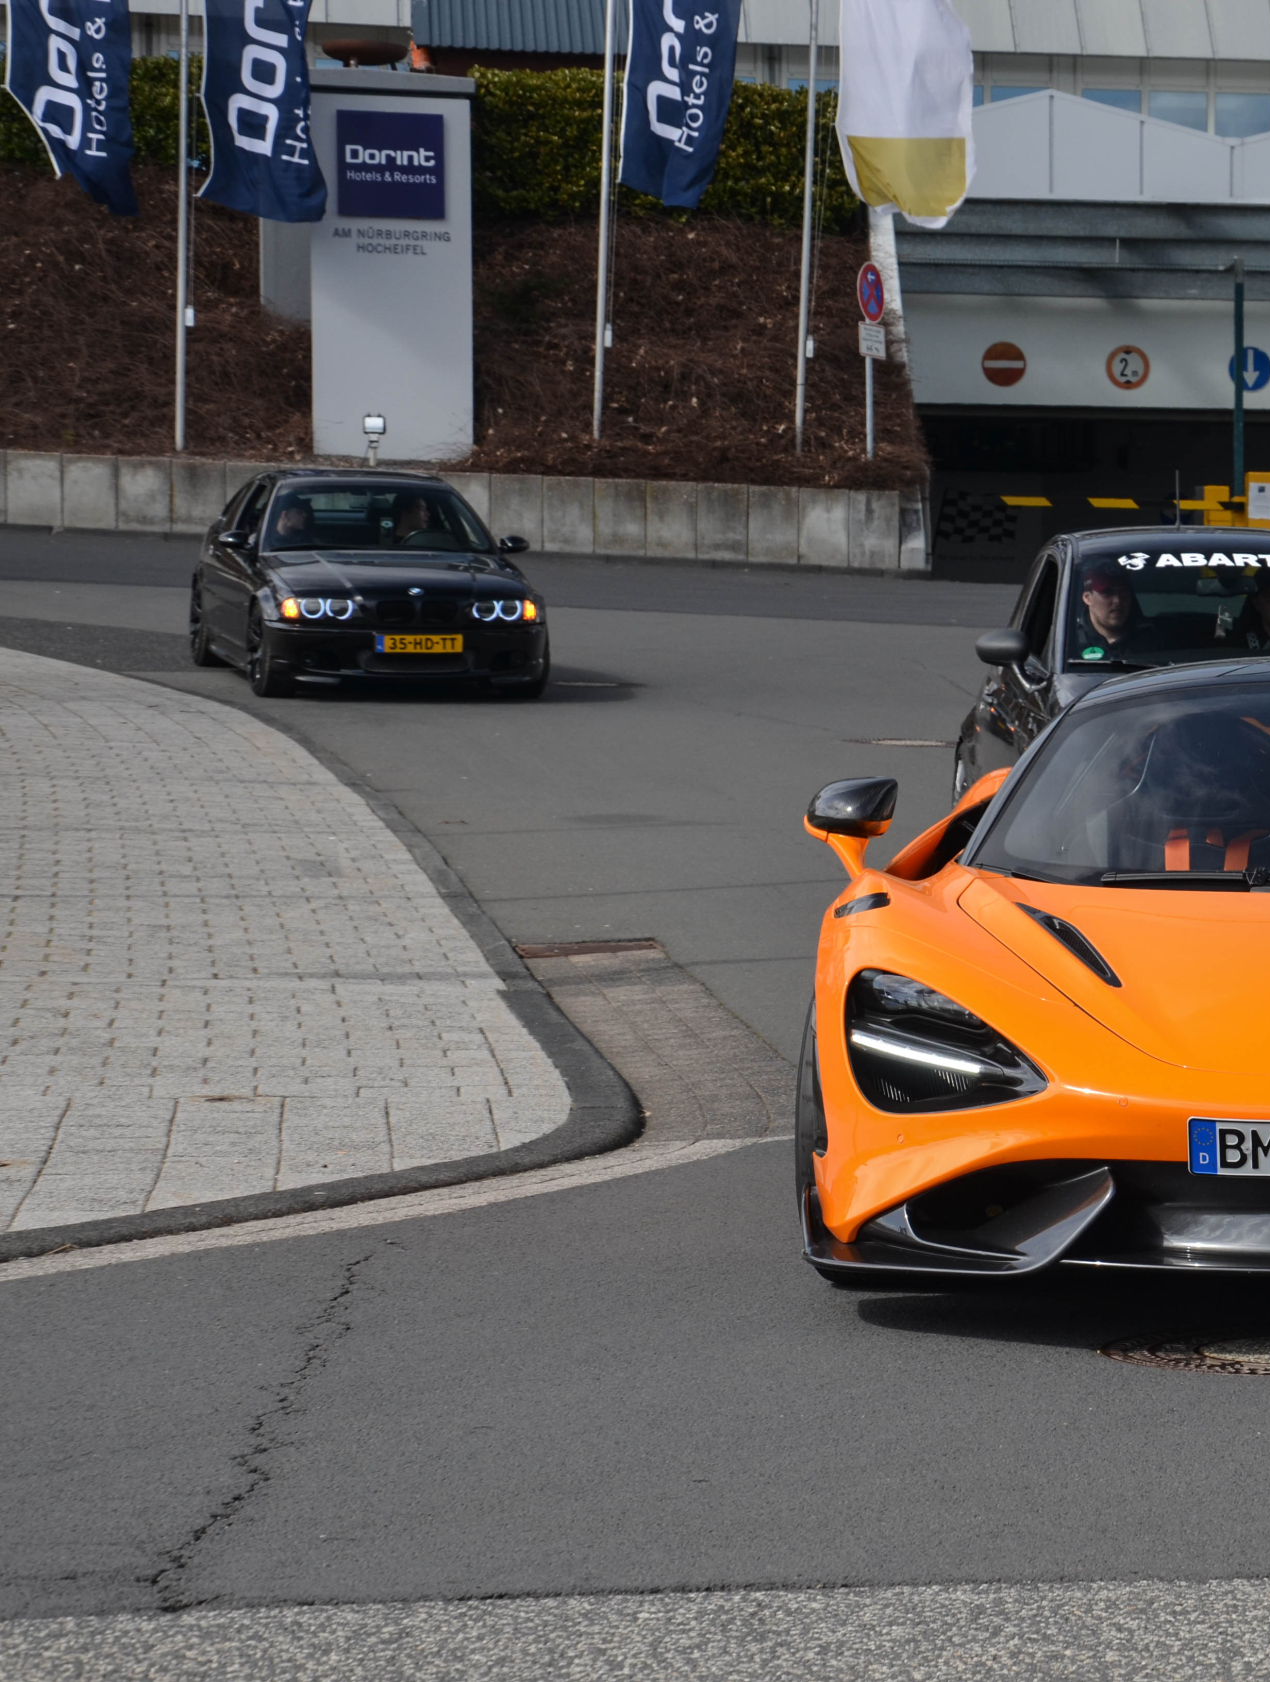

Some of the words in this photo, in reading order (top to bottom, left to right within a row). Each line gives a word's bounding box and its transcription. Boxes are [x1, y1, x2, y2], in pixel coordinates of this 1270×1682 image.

[85, 17, 106, 39] &
[693, 12, 719, 34] &
[674, 46, 713, 152] Hotels
[345, 144, 436, 167] Dorint
[346, 170, 382, 182] Hotels
[384, 171, 393, 182] &
[394, 172, 437, 184] Resorts
[332, 227, 352, 239] AM
[357, 226, 451, 242] NÜRBURGRING
[356, 243, 428, 256] HOCHEIFEL
[1119, 357, 1129, 377] 2
[388, 637, 457, 650] 35-HD-TT
[1199, 1153, 1209, 1164] D
